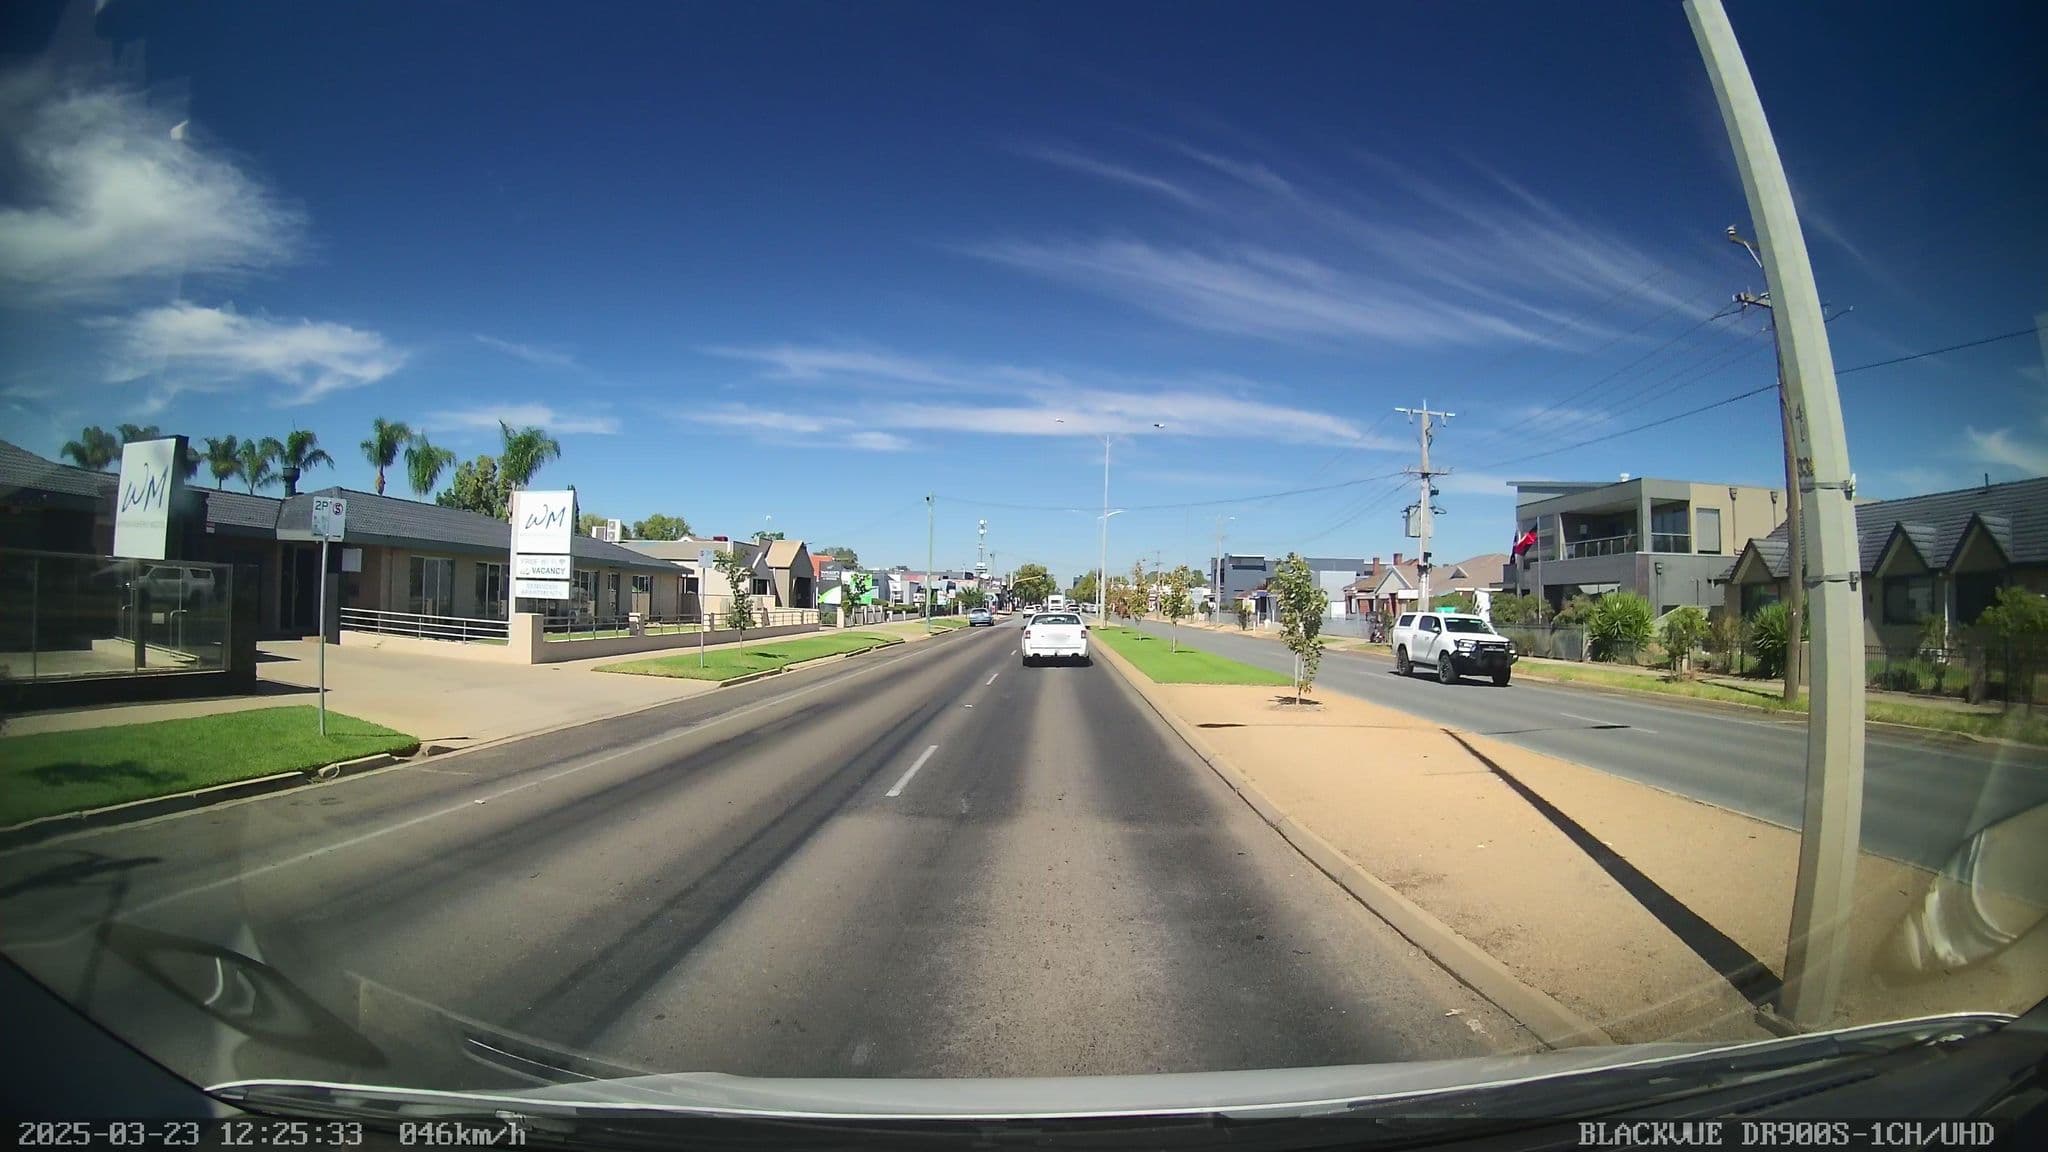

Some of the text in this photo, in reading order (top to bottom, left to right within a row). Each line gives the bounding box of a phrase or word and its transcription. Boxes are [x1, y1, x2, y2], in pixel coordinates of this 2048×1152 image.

[121, 462, 168, 512] WM
[525, 504, 566, 530] WM
[532, 567, 566, 575] VACANCY
